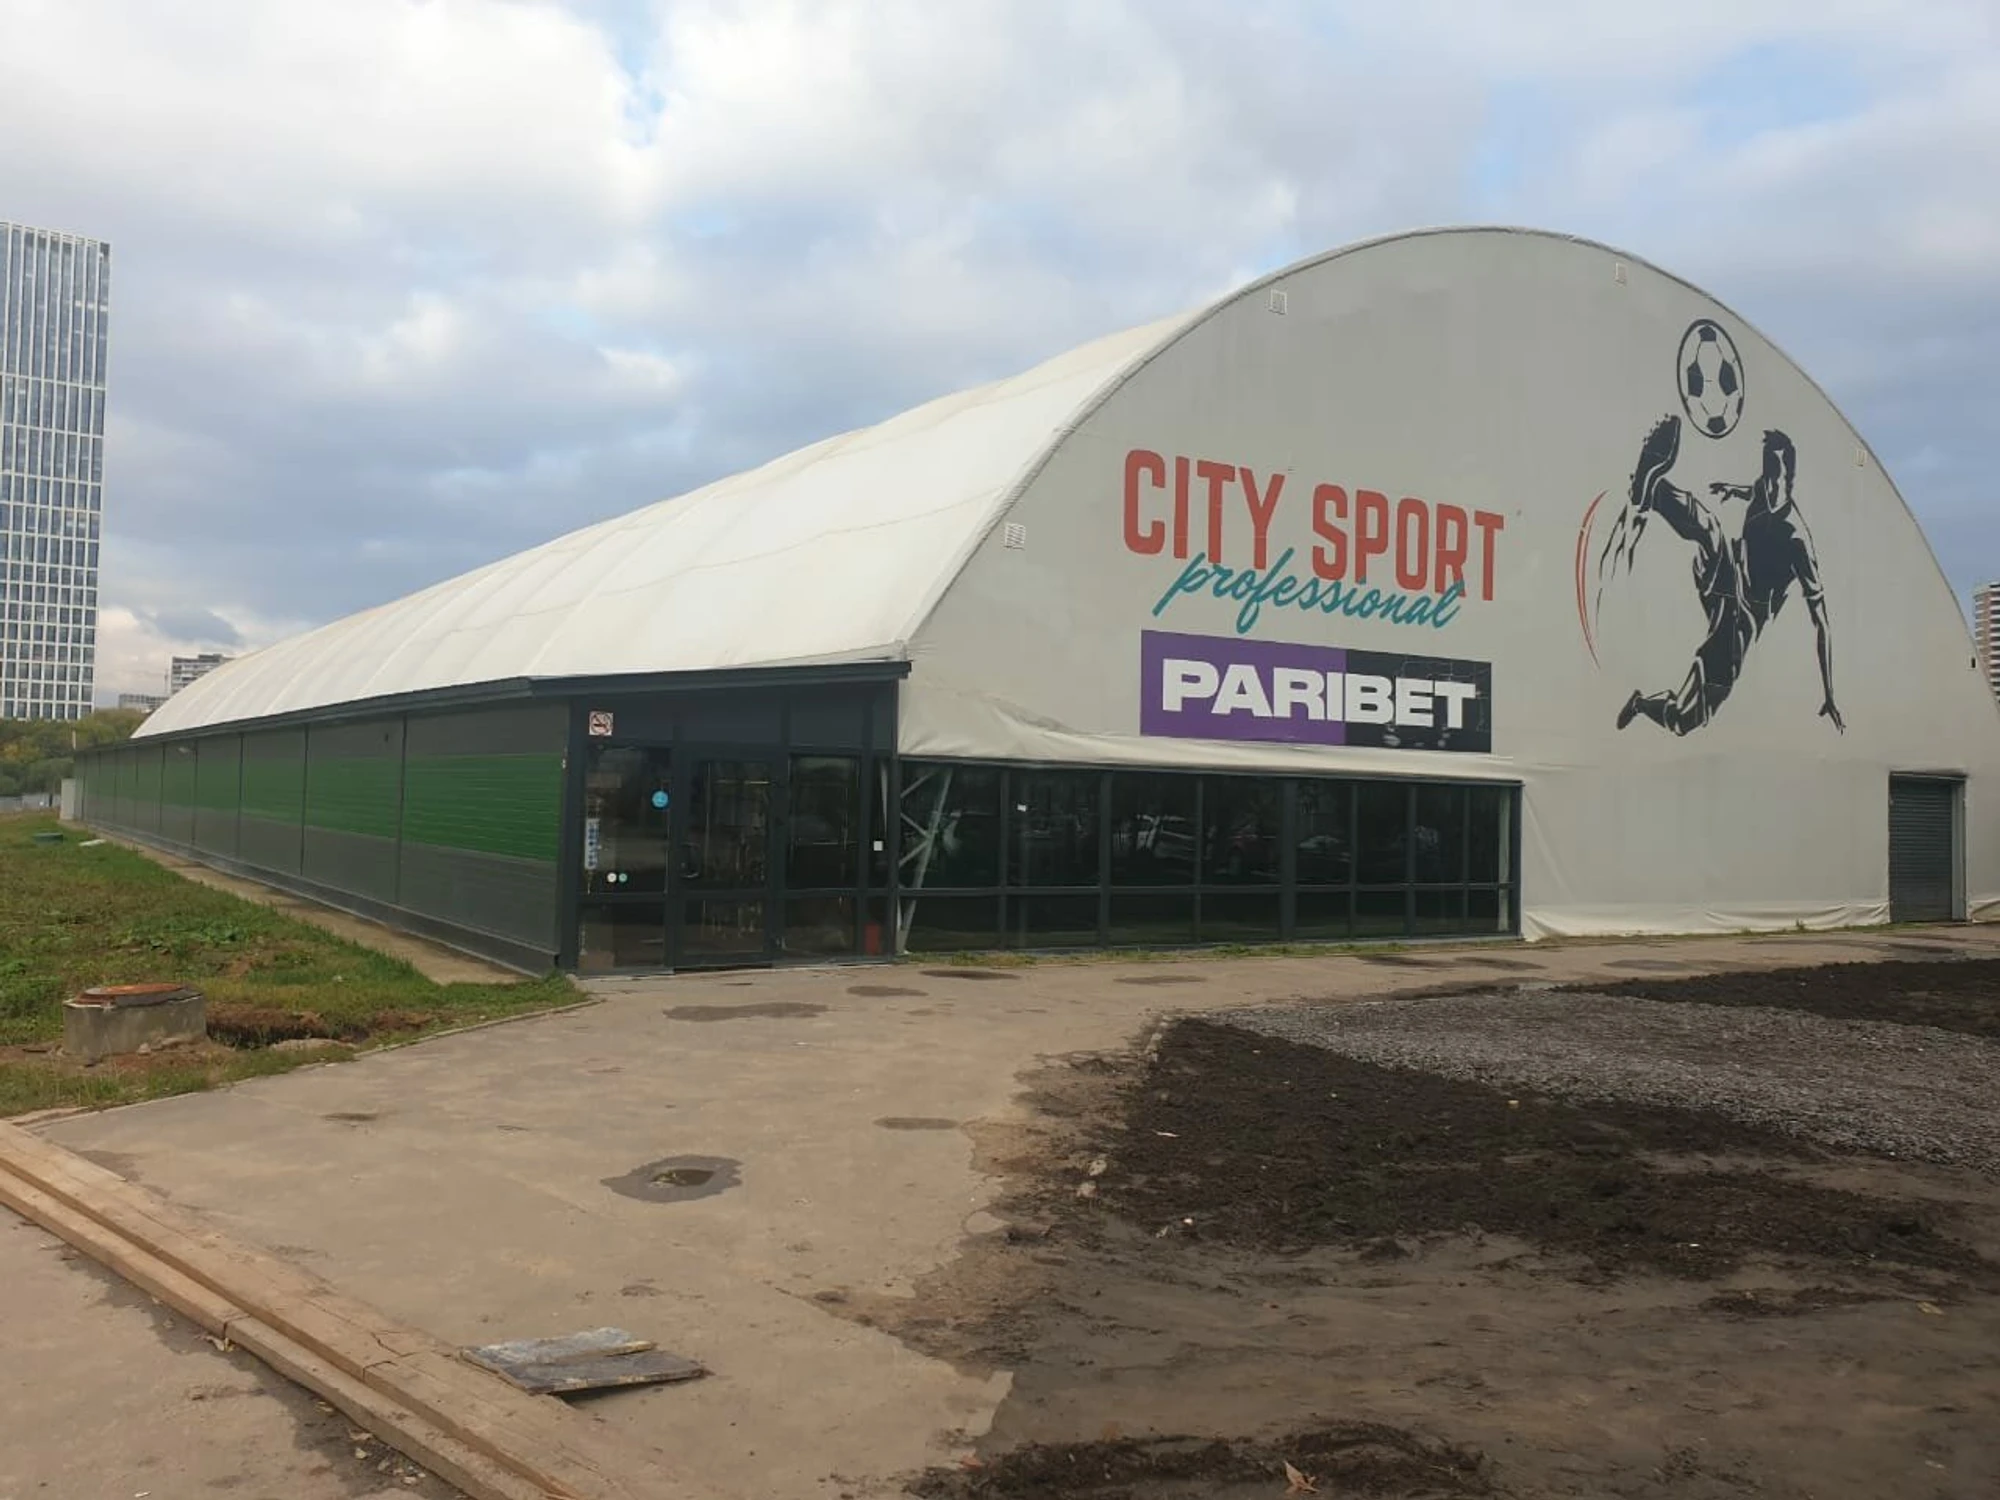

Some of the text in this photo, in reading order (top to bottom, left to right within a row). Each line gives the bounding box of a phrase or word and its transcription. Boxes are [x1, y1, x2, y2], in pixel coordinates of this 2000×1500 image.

[1123, 449, 1504, 601] CITY SPORT
[1152, 547, 1465, 634] professional
[1162, 658, 1476, 729] PARIBET
